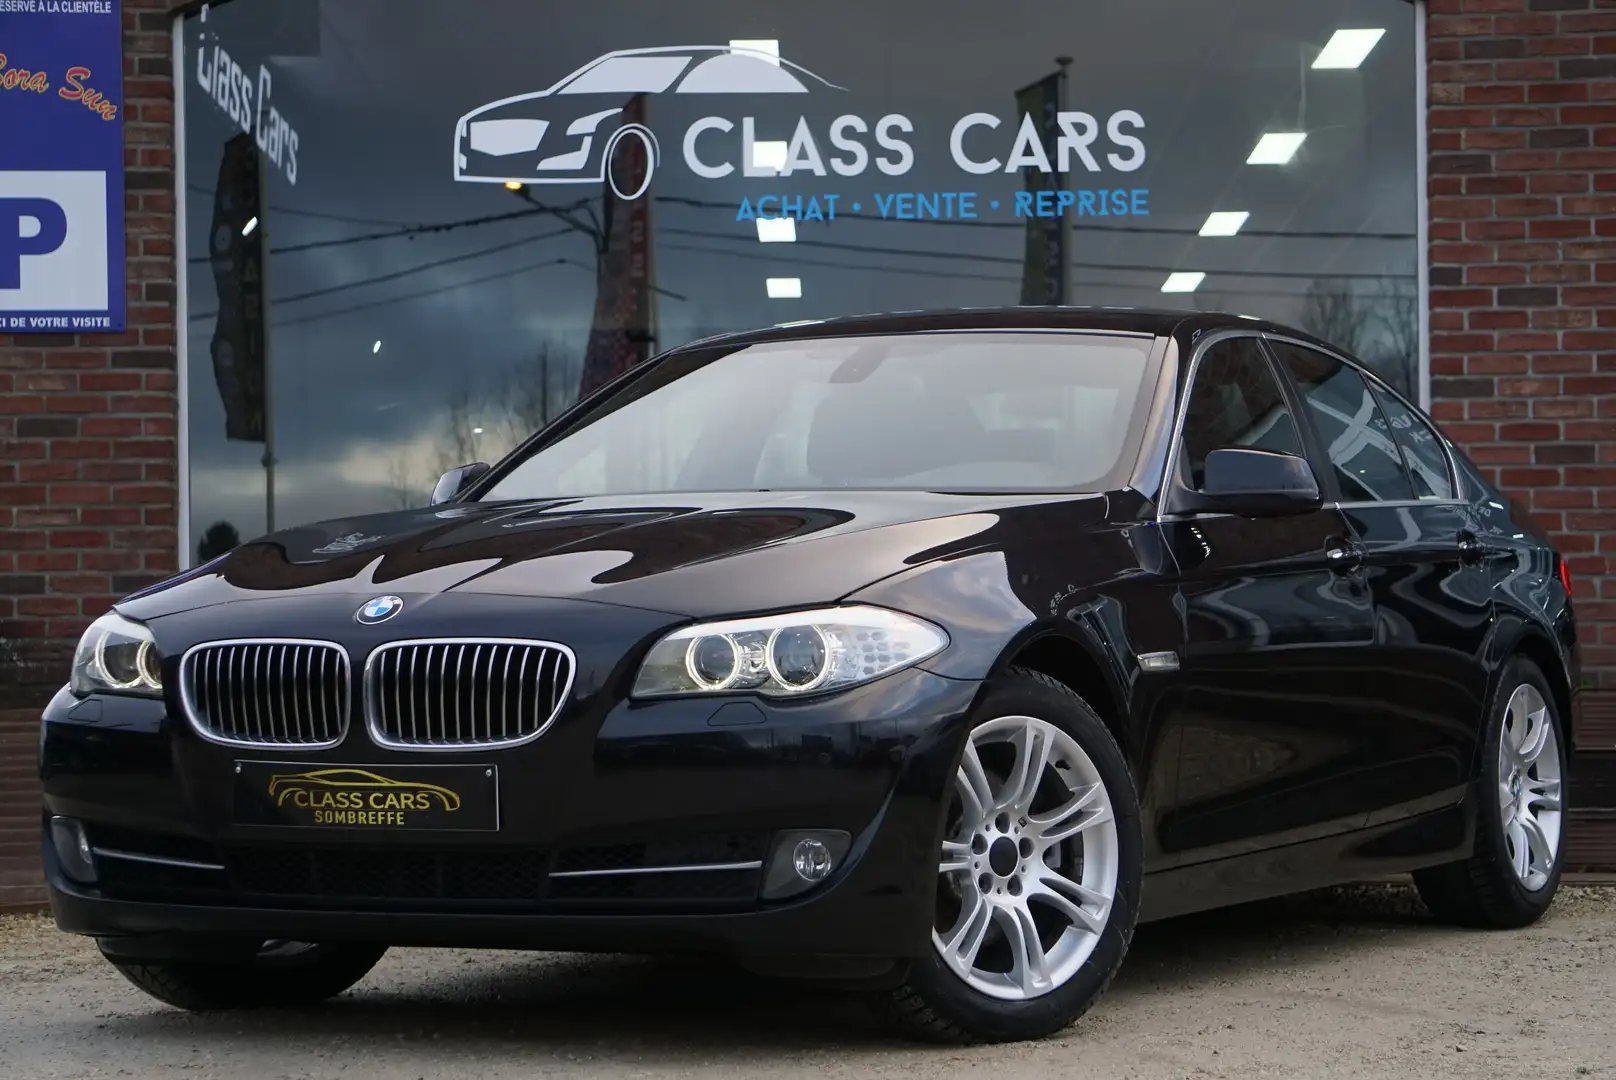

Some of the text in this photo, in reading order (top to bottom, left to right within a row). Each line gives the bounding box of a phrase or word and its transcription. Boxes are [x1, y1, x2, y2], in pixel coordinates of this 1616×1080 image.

[47, 1, 60, 12] LA
[58, 67, 117, 120] Sun
[197, 3, 299, 186] Class Cars
[683, 110, 1146, 179] CLASS CARS
[736, 189, 1150, 221] ACHAT VENTE REPRISE
[0, 197, 67, 289] P
[10, 317, 26, 328] DE
[29, 317, 69, 328] VOTRE
[72, 317, 111, 328] VISITE
[294, 791, 430, 809] CLASS CARS
[314, 810, 405, 825] SOMBREFFE
